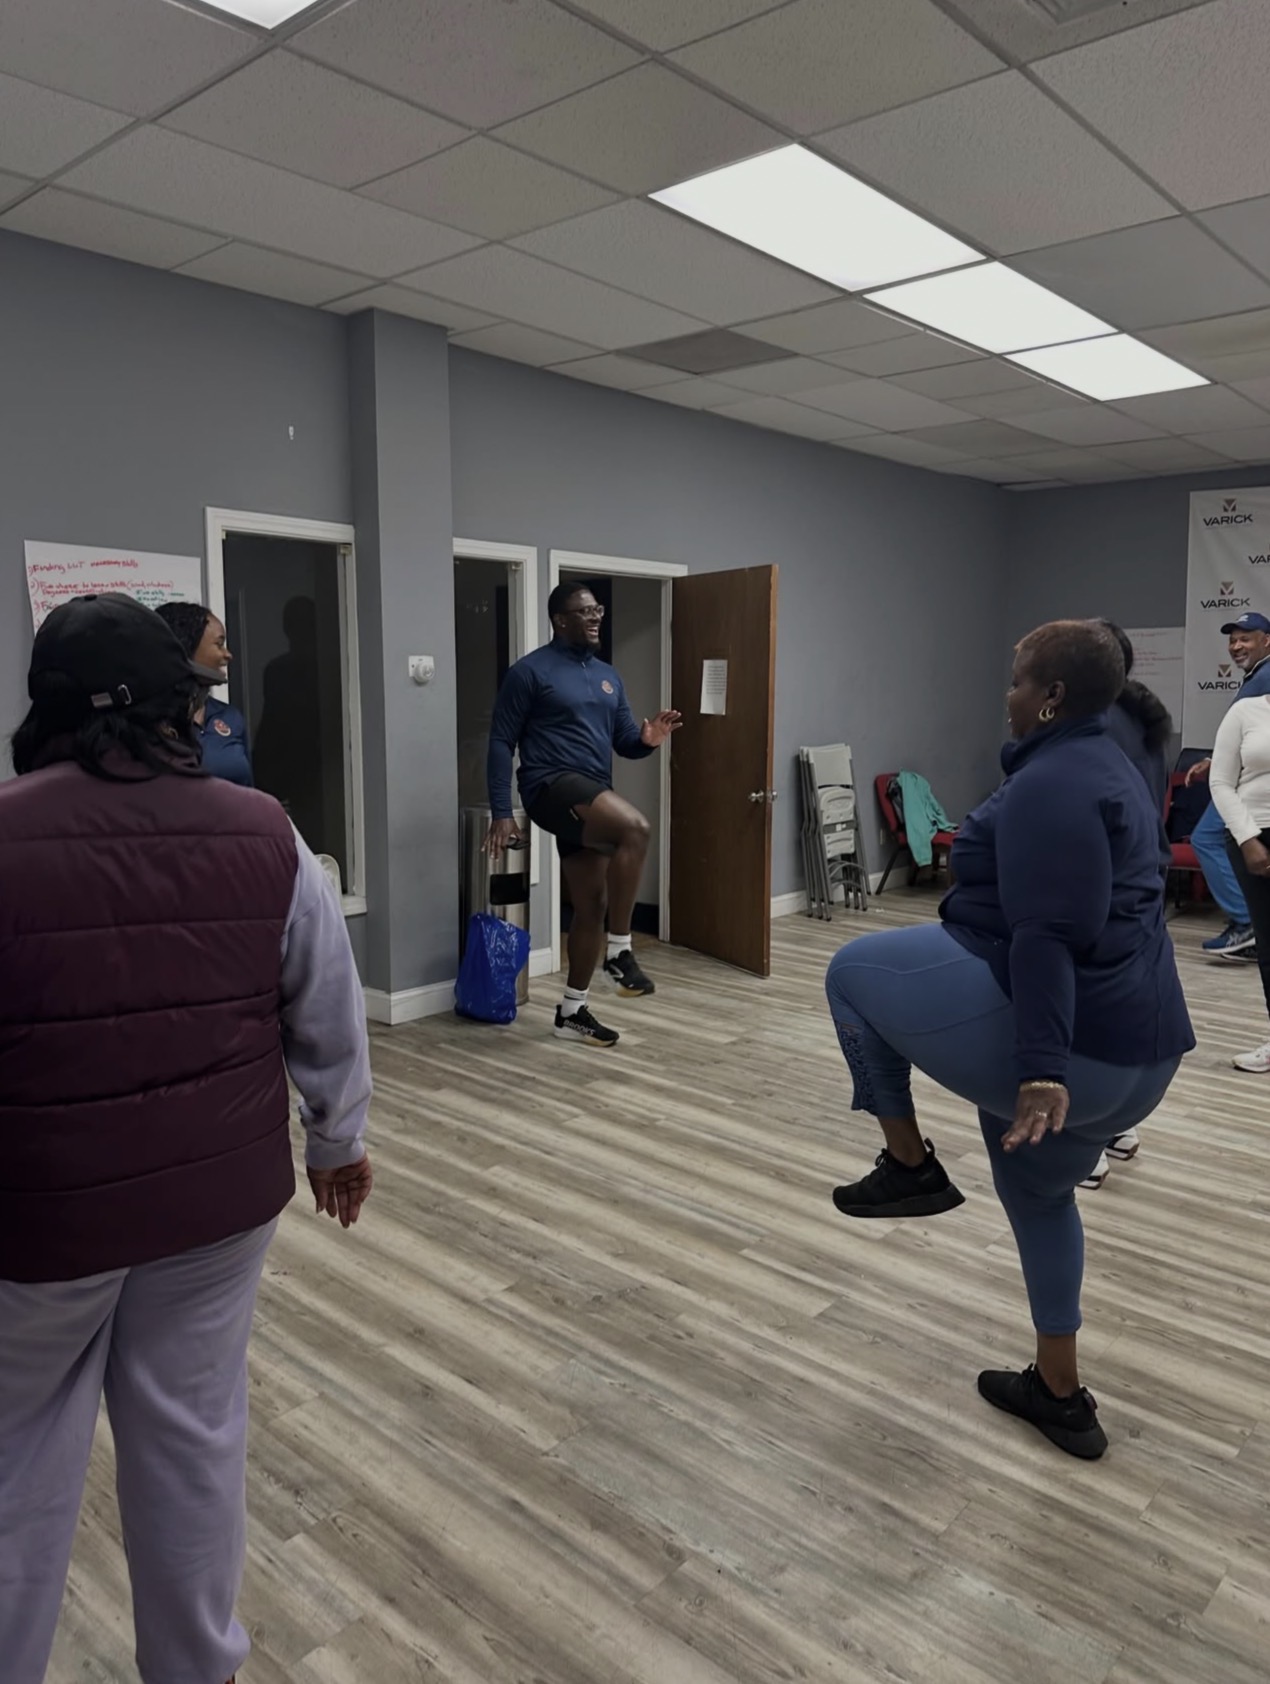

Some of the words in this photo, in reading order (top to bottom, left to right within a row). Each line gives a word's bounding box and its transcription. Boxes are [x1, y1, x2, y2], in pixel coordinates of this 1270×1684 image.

[1203, 514, 1253, 526] VARICK
[1200, 598, 1250, 609] VARICK
[563, 1020, 597, 1036] BROOKS
